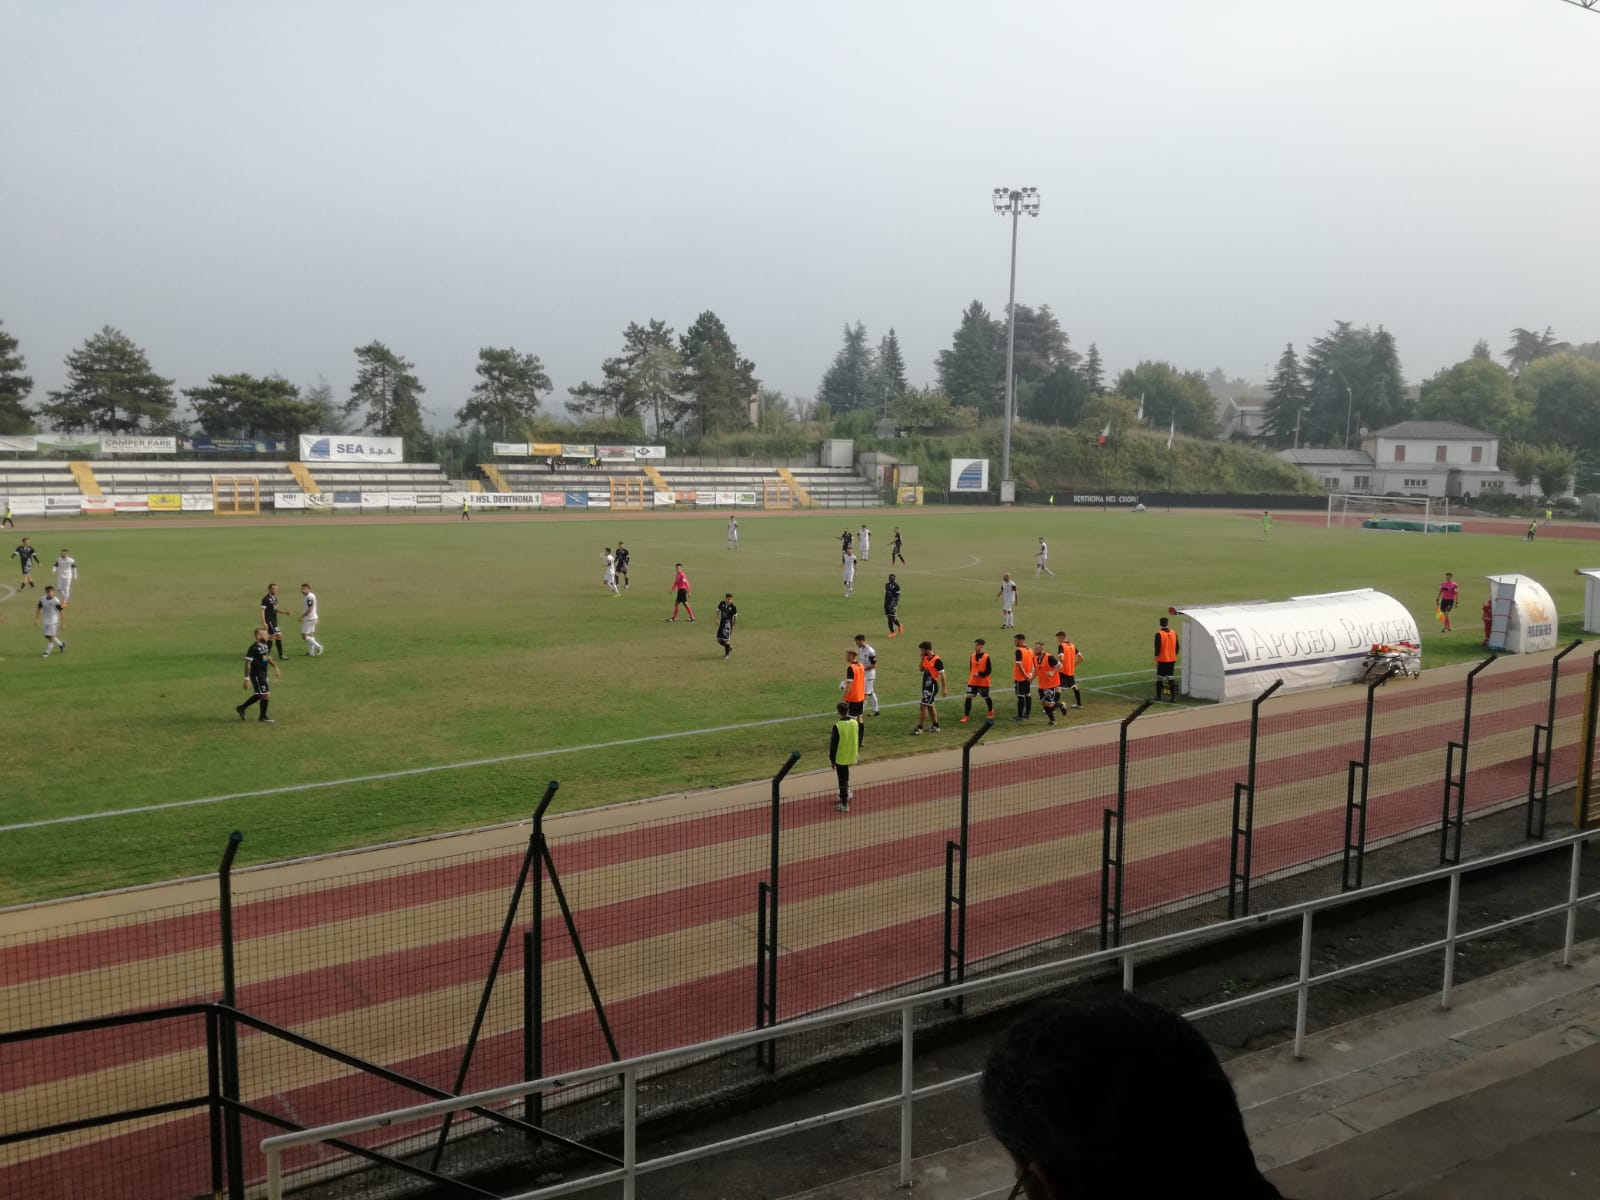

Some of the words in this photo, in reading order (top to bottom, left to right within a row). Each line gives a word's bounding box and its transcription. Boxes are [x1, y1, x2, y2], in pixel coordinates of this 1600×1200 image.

[105, 439, 145, 447] CAMPER
[147, 439, 172, 447] PARK
[336, 443, 364, 454] SEA
[369, 447, 396, 456] S.p.A.
[475, 495, 491, 503] HSL
[493, 495, 534, 504] DERTHONA
[1073, 495, 1104, 503] DERTHONA
[1250, 626, 1336, 661] APOGEO
[1339, 617, 1418, 649] BROKER
